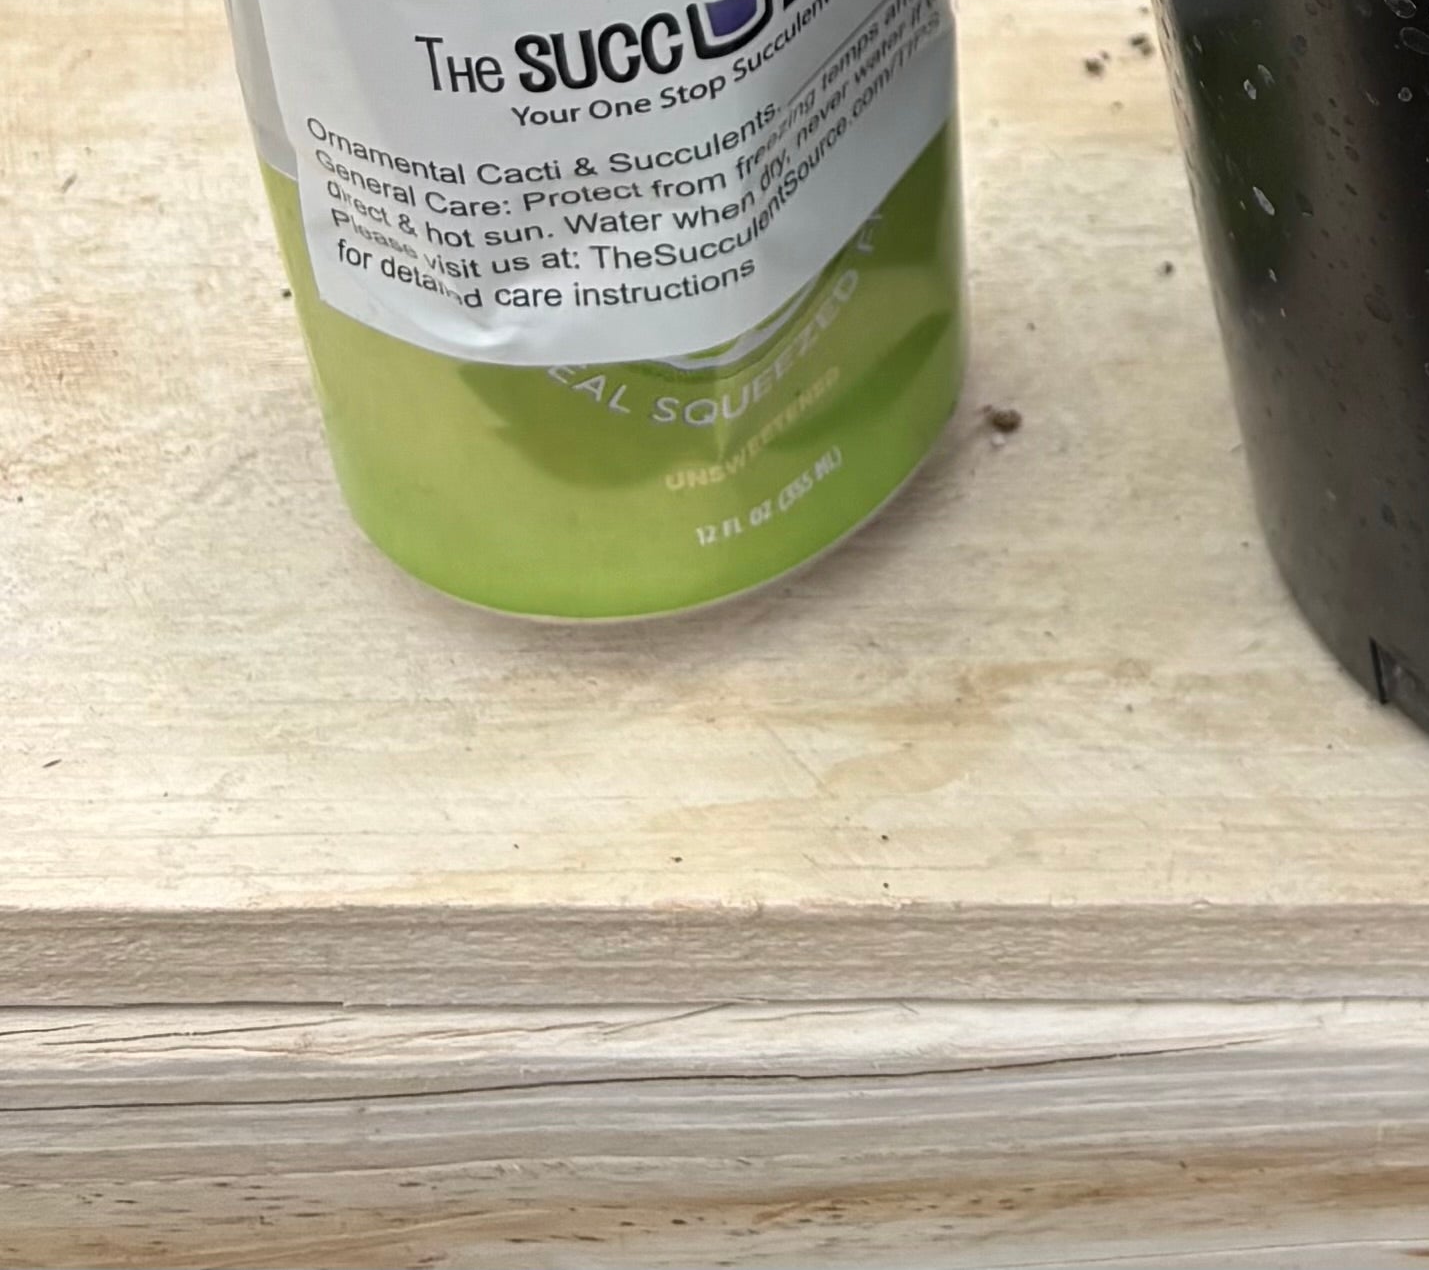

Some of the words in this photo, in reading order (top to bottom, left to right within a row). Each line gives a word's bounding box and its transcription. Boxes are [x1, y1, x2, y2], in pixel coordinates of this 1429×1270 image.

[316, 149, 416, 207] General
[425, 191, 511, 217] Care:
[523, 182, 644, 211] Protect
[651, 171, 726, 199] from
[736, 88, 816, 180] freezing
[822, 22, 879, 91] temps
[327, 180, 392, 227] direct
[399, 214, 418, 238] &
[426, 221, 475, 247] hot
[485, 224, 554, 246] sun.
[564, 212, 662, 234] Water
[673, 191, 754, 230] when
[760, 148, 791, 192] dry,
[797, 80, 849, 147] never
[855, 22, 906, 85] water
[511, 106, 581, 127] Your
[588, 98, 651, 119] One
[660, 75, 726, 109] Stop
[307, 118, 466, 184] Ornamental
[477, 160, 561, 184] Cacti
[574, 157, 598, 177] &
[609, 102, 781, 173] Succulents.
[331, 208, 418, 259] Please
[424, 254, 482, 279] visit
[492, 255, 530, 274] us
[541, 248, 580, 270] at:
[338, 239, 373, 270] for
[381, 256, 483, 308] detaid
[495, 286, 562, 308] care
[573, 259, 755, 307] instructions
[549, 362, 631, 414] EAL
[653, 268, 859, 427] SQUEEZED
[696, 524, 717, 546] 12
[723, 517, 743, 538] FL
[749, 500, 773, 526] OZ
